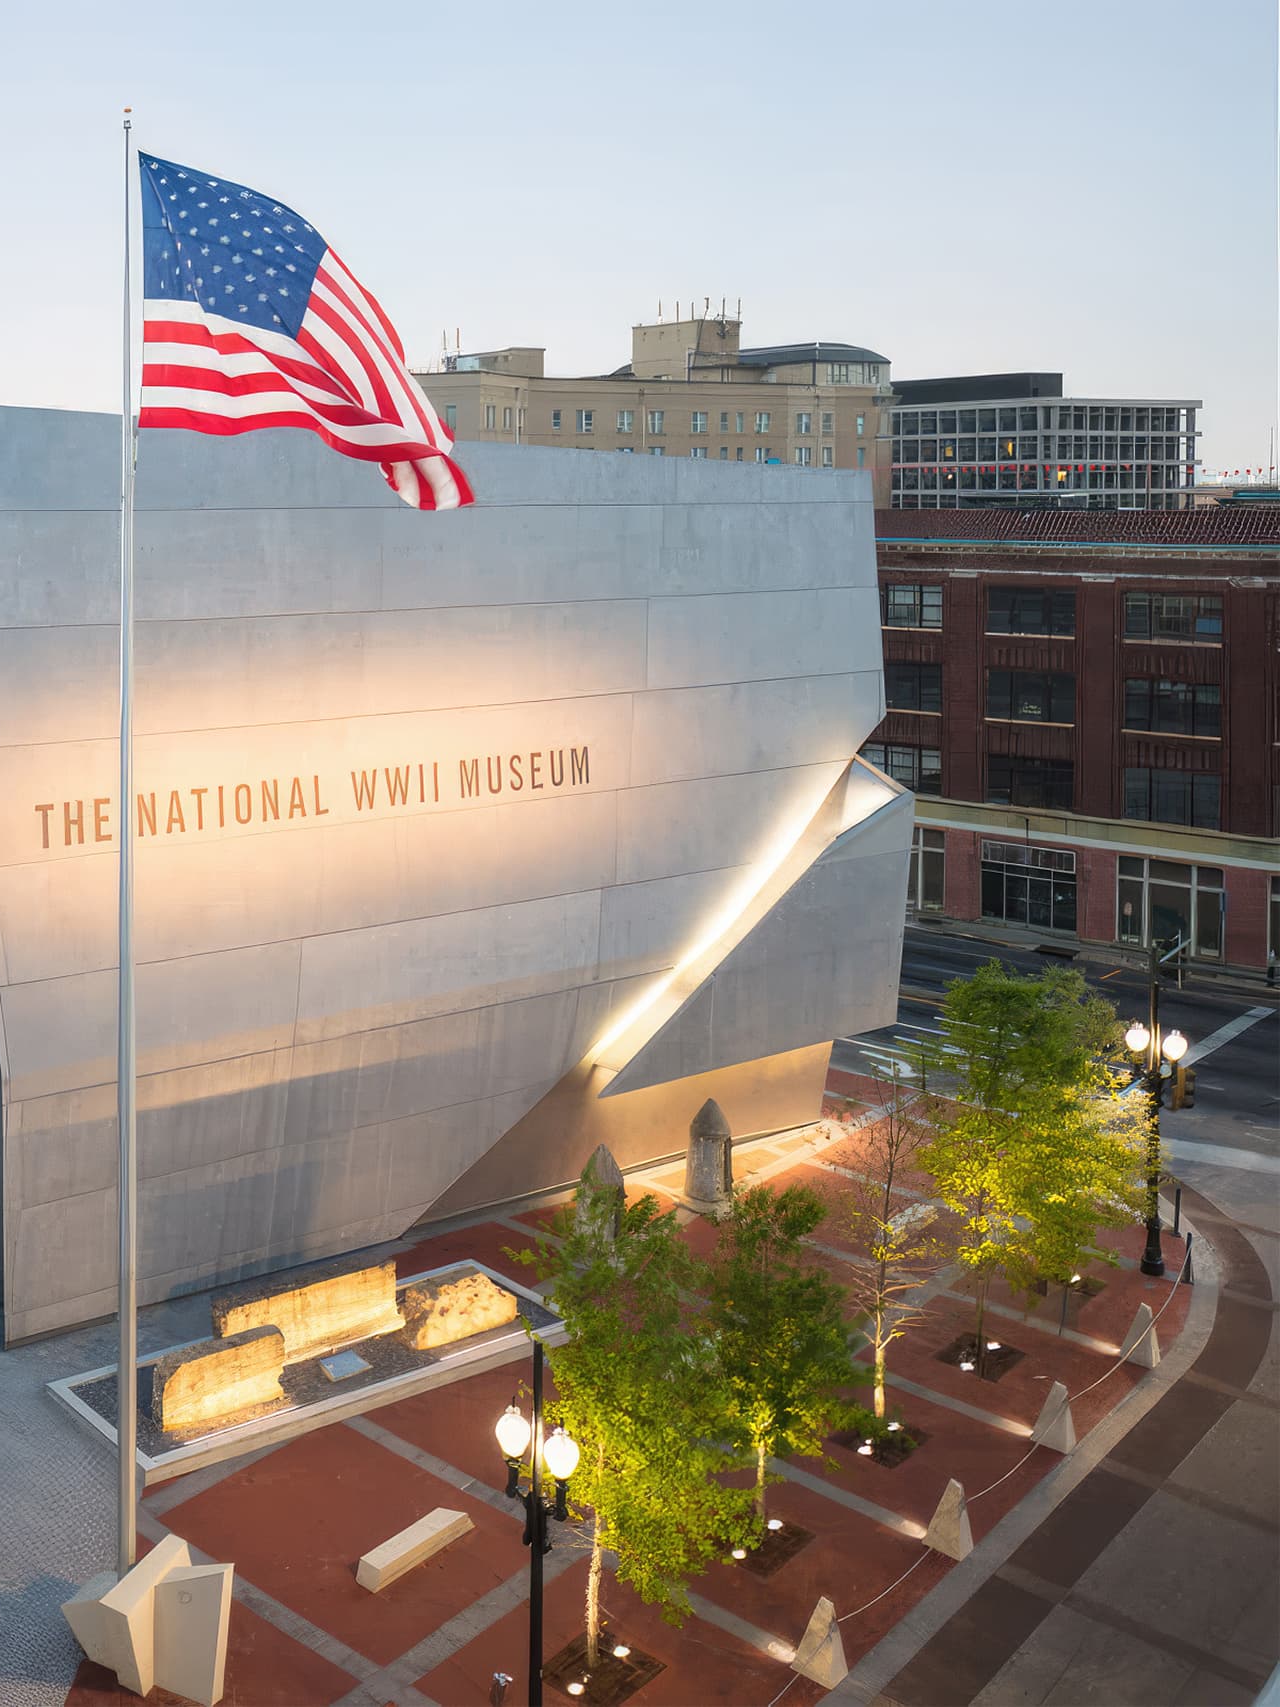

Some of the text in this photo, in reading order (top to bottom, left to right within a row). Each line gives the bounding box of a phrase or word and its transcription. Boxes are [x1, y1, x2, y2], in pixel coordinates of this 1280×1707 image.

[35, 746, 590, 848] THE NATIONAL WWII MUSEUM
